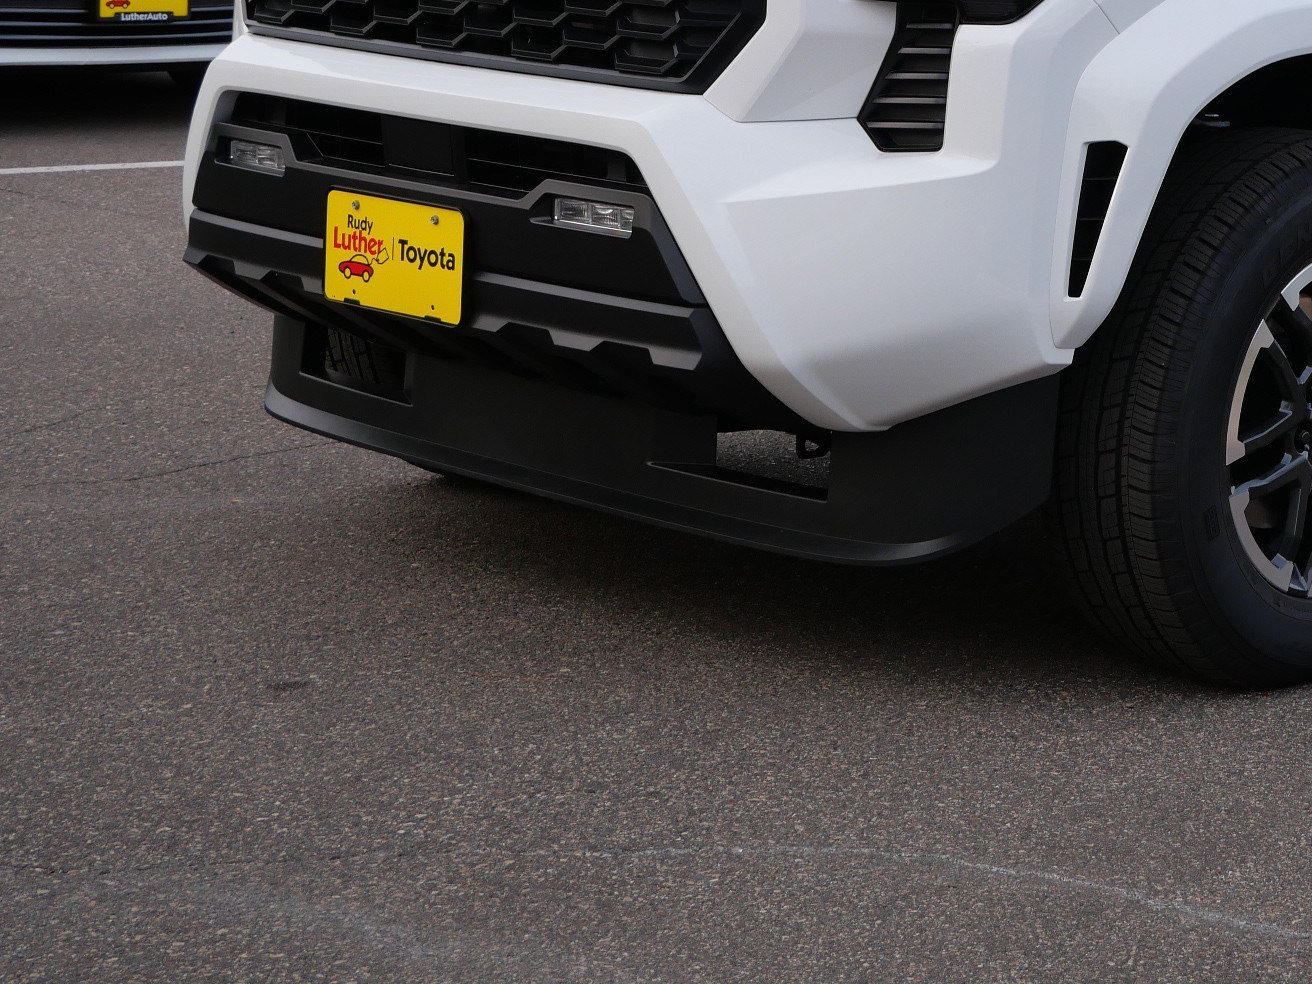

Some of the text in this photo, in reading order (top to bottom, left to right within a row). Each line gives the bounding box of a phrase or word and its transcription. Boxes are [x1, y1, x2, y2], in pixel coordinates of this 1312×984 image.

[121, 13, 168, 21] LutherAuto
[347, 214, 373, 235] Rudy
[333, 226, 384, 256] Luther
[398, 239, 455, 271] Toyota
